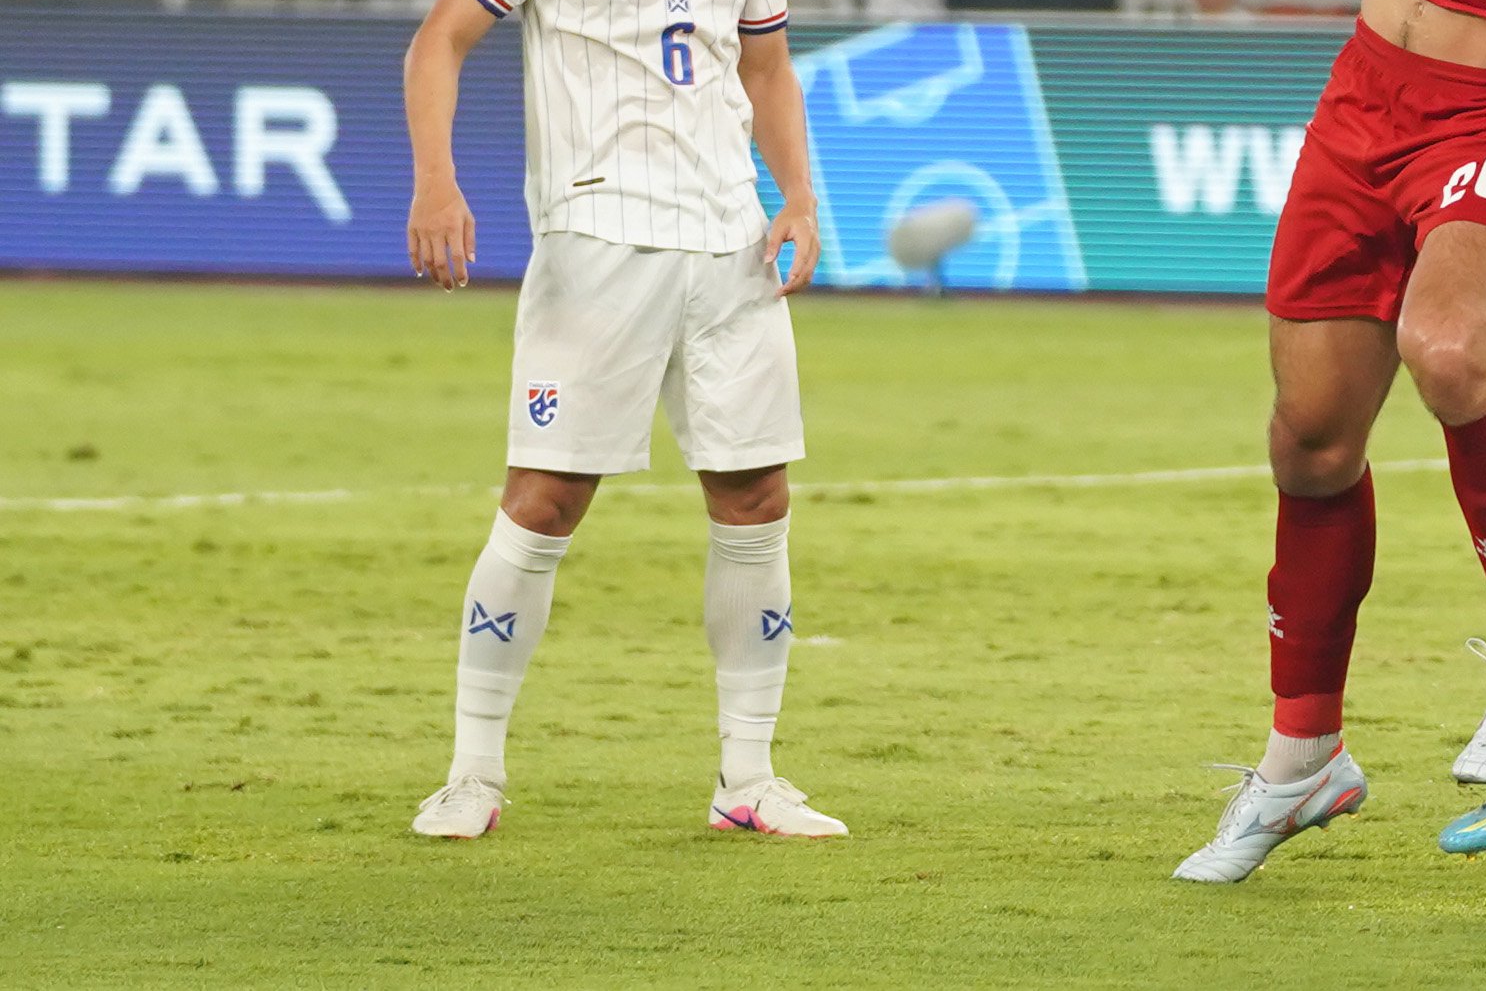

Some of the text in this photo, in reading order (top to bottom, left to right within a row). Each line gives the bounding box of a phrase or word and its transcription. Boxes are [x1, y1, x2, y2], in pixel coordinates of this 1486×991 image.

[661, 22, 696, 86] 6
[1, 82, 352, 225] TAR
[1150, 122, 1306, 215] ww
